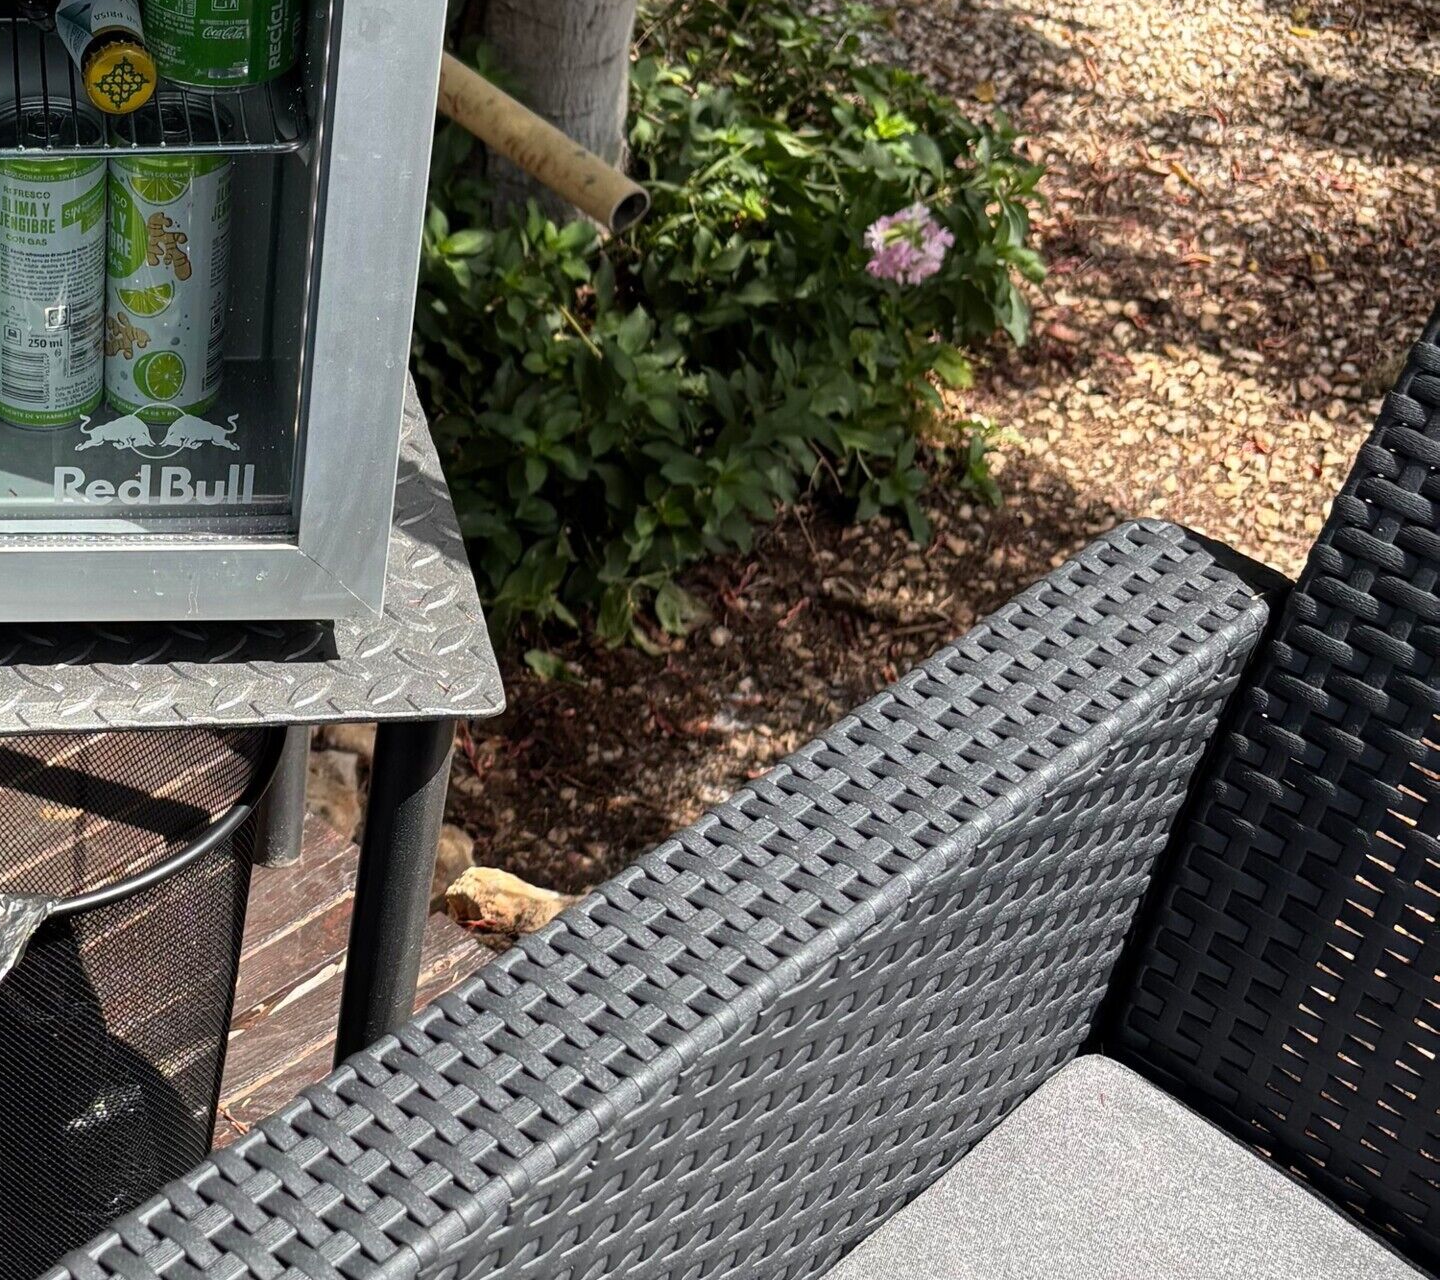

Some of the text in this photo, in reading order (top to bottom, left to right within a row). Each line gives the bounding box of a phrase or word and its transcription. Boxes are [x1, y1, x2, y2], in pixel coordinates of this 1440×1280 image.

[6, 233, 48, 247] CON GAS
[28, 338, 64, 349] 250 ml
[54, 464, 255, 505] Red Bull
